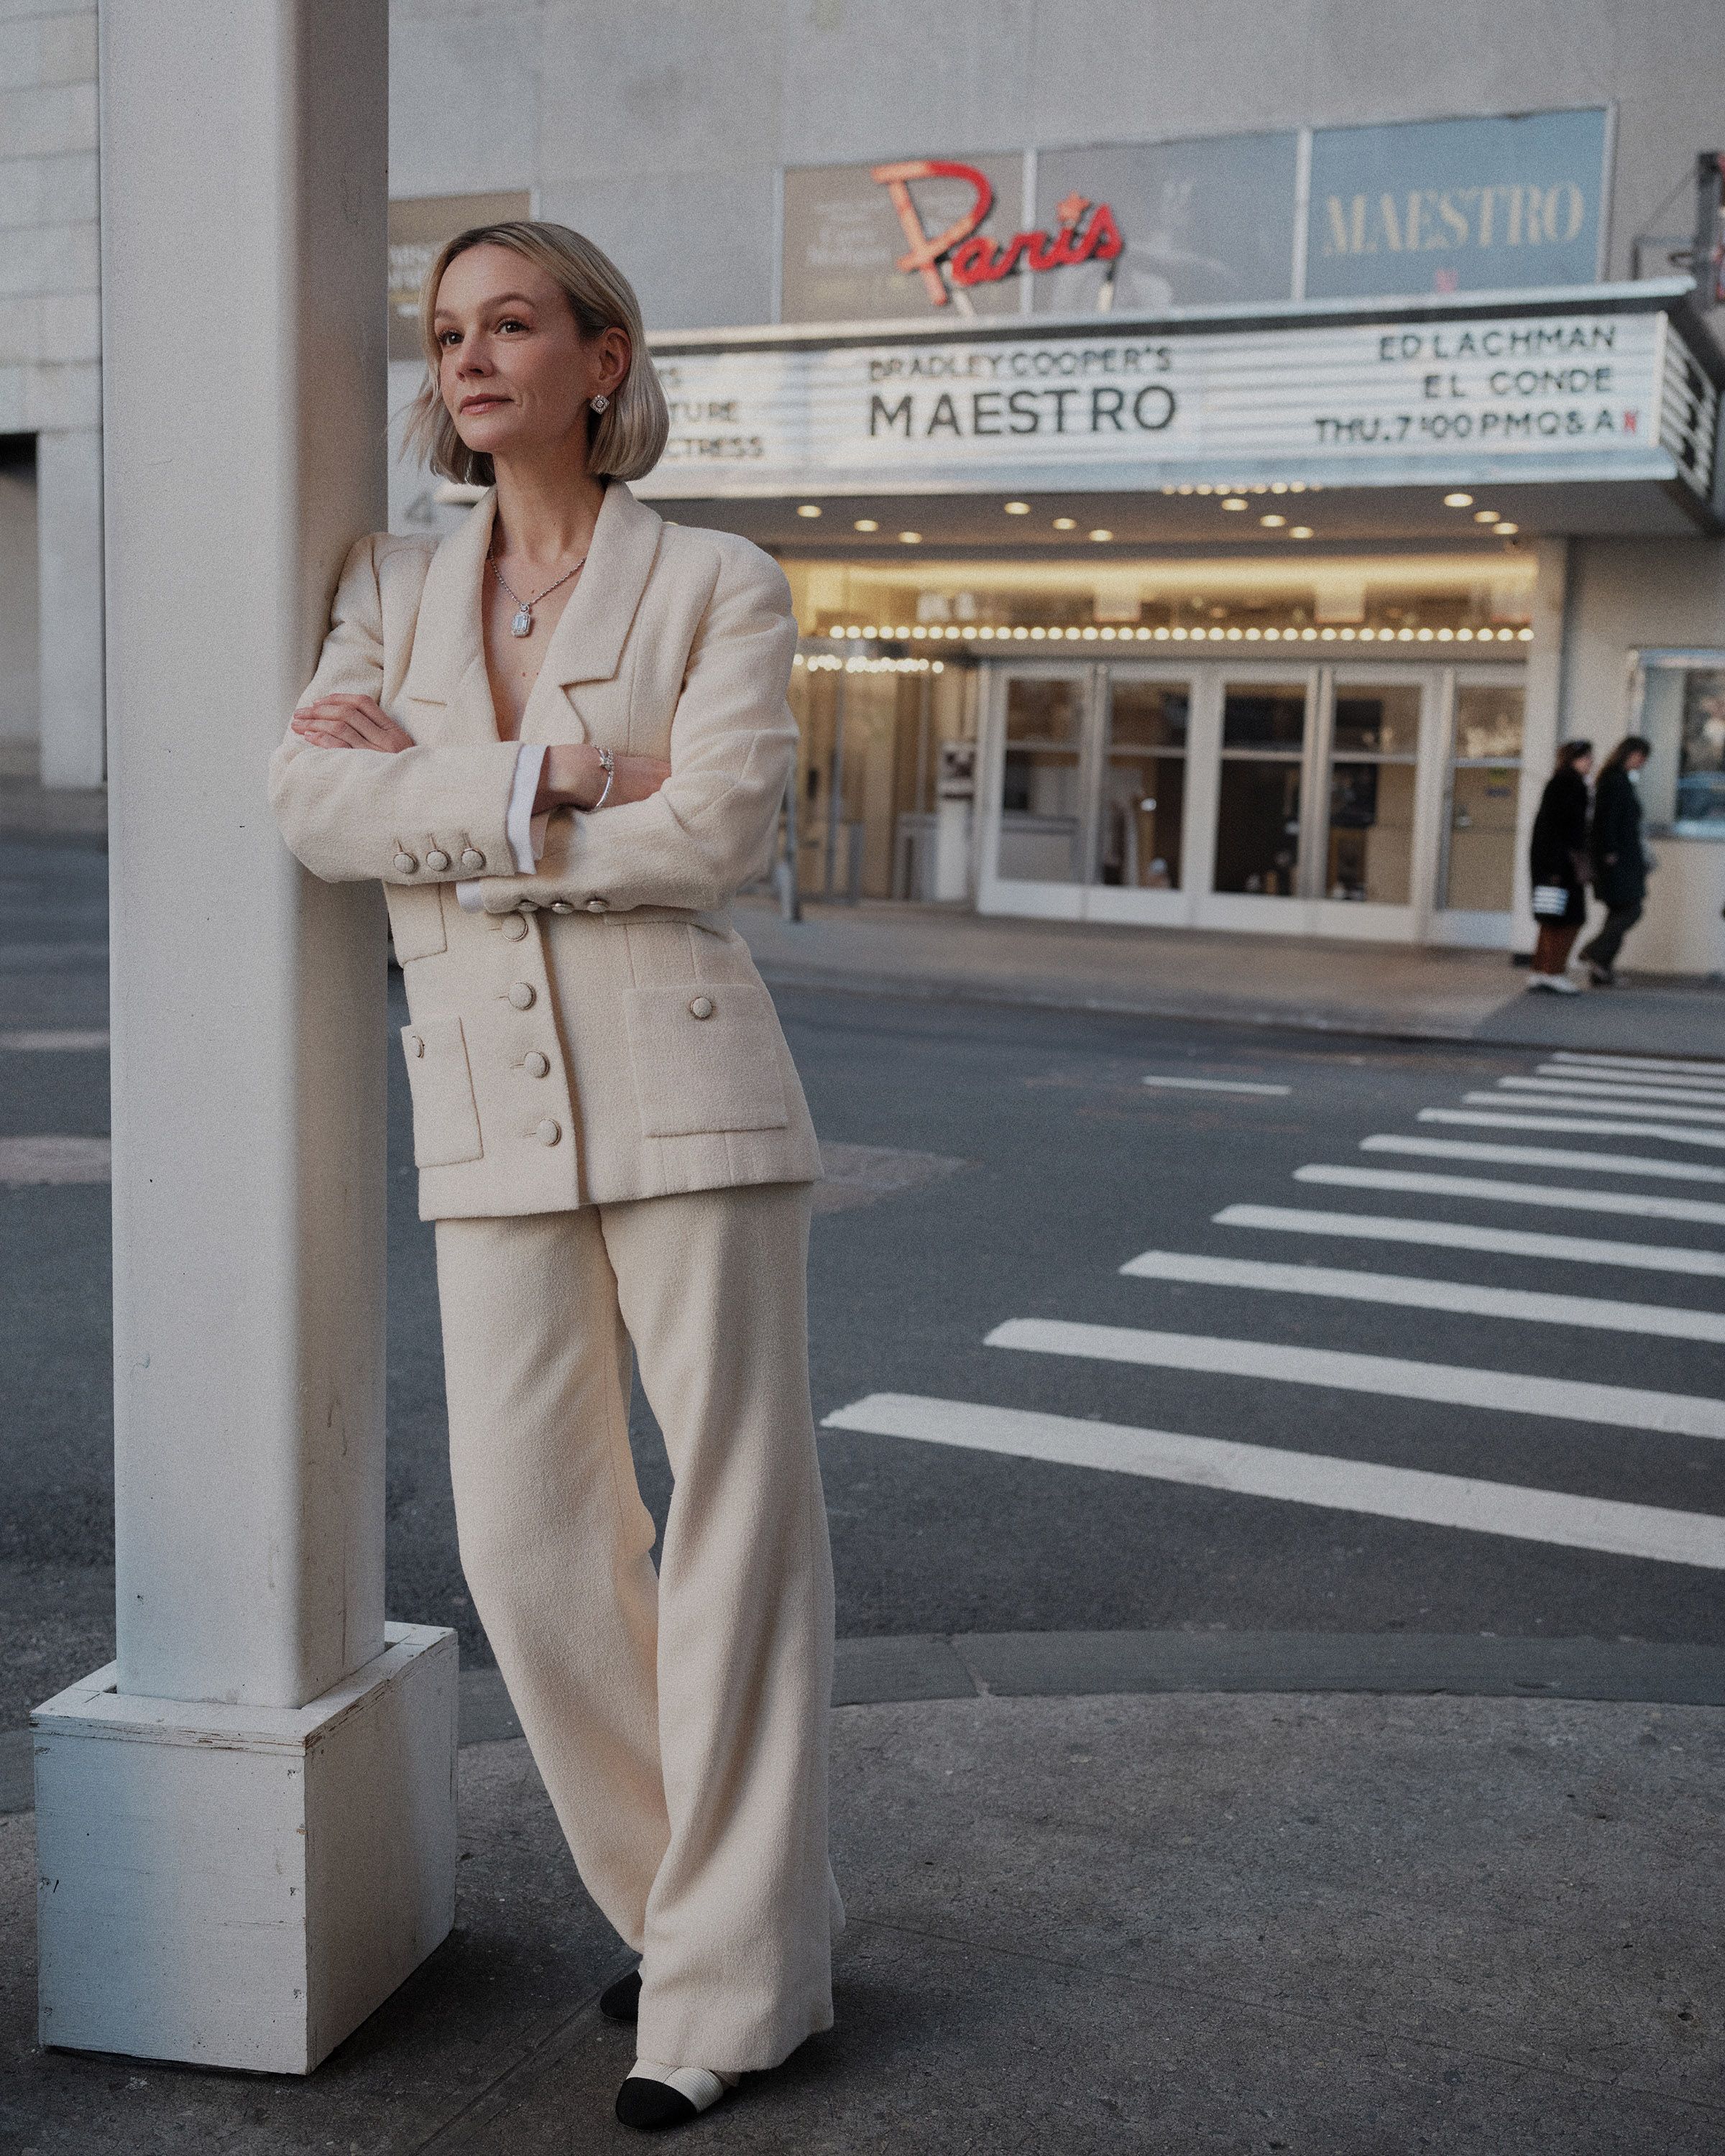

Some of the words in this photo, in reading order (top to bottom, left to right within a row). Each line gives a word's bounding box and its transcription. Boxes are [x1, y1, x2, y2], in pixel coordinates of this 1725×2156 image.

[870, 160, 1123, 305] Paris
[1322, 180, 1583, 256] MAESTRO
[870, 355, 1002, 382] BRADLEY
[1011, 347, 1172, 377] COOPER'S
[1380, 333, 1422, 361] ED
[1435, 326, 1616, 359] LACHMAN
[1424, 374, 1467, 399] EL
[1489, 367, 1614, 395] CONDE
[870, 384, 1177, 437] MAESTRO
